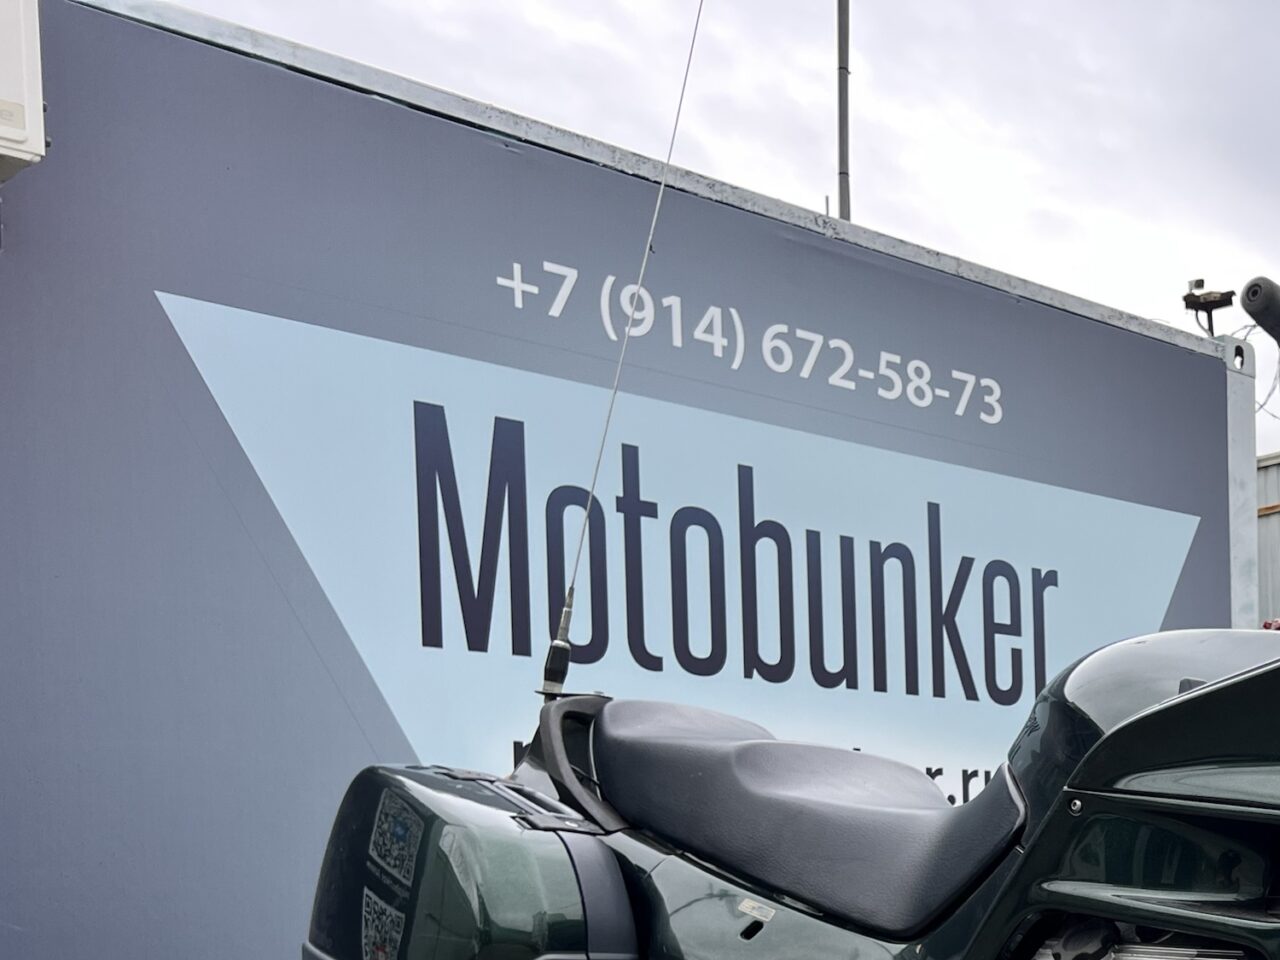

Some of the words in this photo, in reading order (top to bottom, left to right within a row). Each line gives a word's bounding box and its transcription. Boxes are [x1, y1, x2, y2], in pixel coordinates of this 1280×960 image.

[495, 260, 579, 318] +7
[599, 273, 746, 370] (914)
[760, 324, 1004, 425] 672-58-73
[412, 399, 1059, 707] Motobunker
